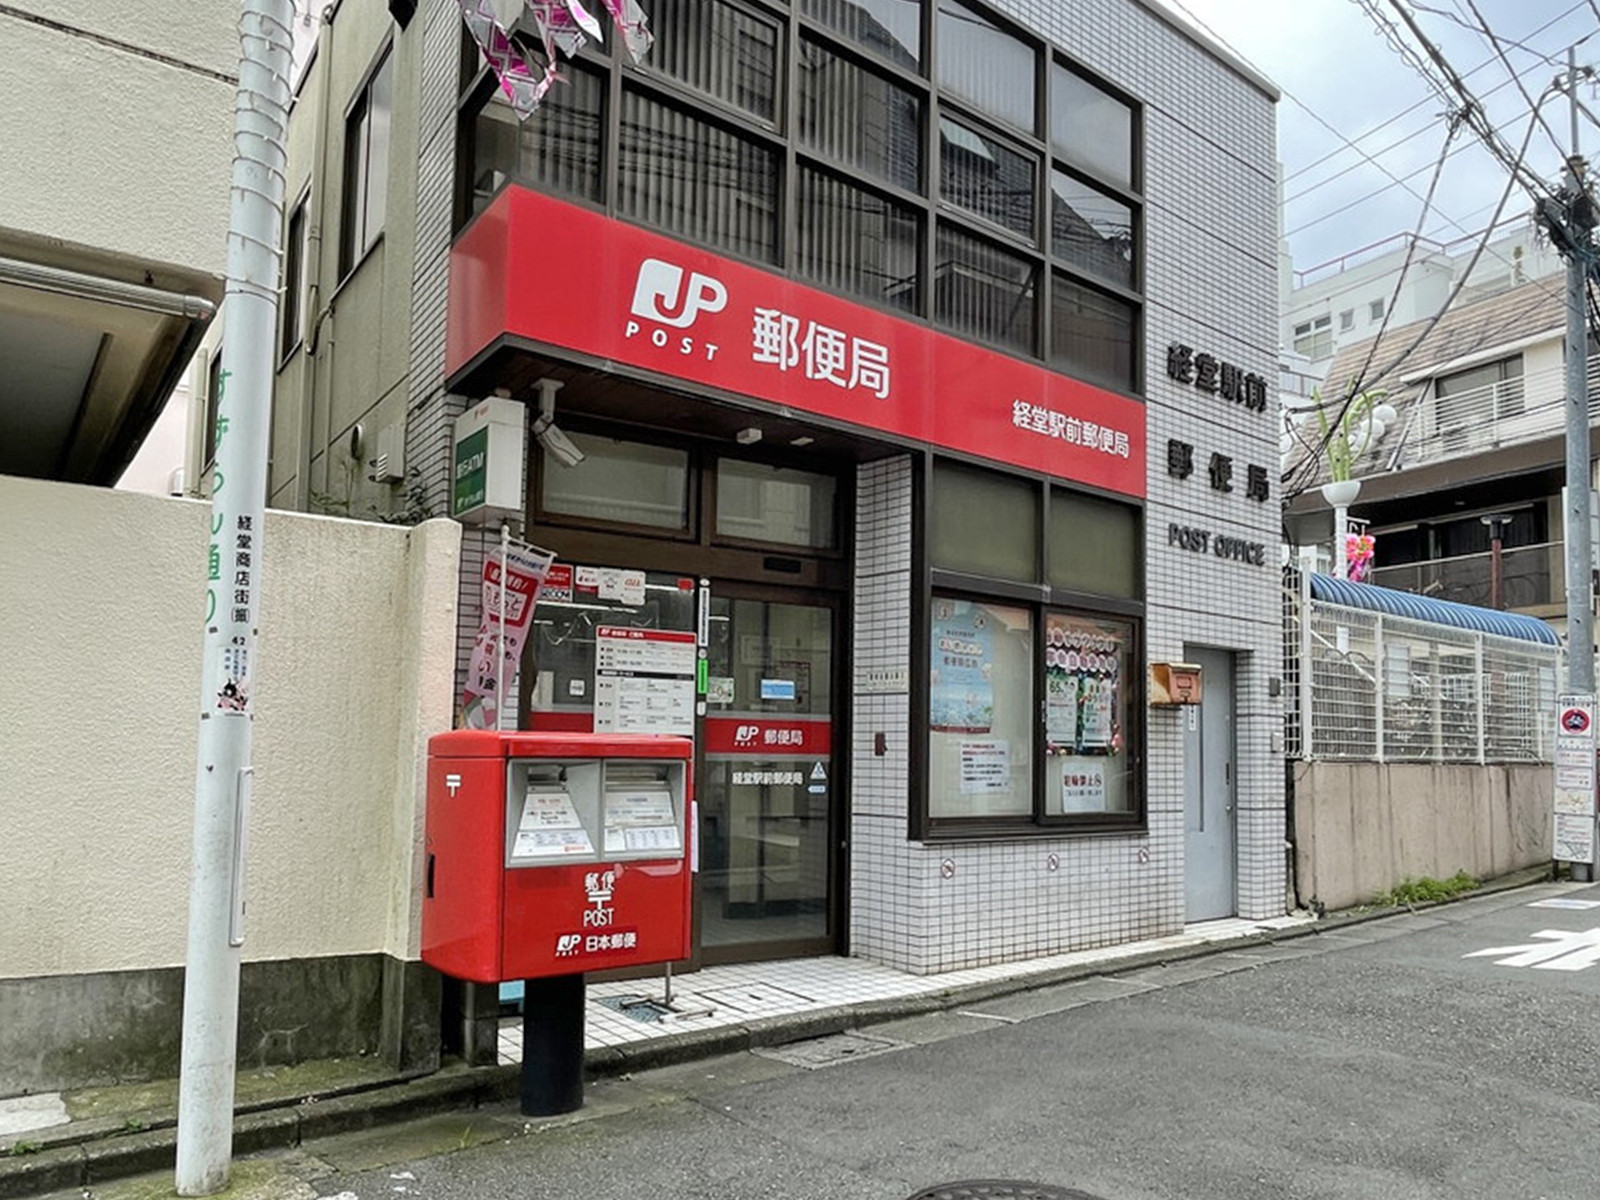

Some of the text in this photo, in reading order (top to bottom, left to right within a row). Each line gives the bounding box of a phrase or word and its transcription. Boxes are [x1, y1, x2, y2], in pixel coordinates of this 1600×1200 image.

[630, 258, 729, 329] JP
[625, 321, 718, 360] POST
[751, 306, 891, 400] 郵便局
[1166, 340, 1268, 414] 経堂駅前
[1012, 399, 1130, 459] 経堂駅前郵便局
[1166, 438, 1270, 503] 郵便局
[1168, 521, 1266, 567] POST OFFICE
[231, 636, 246, 647] 42
[764, 729, 803, 745] 郵便局
[584, 871, 616, 893] 郵便
[583, 907, 615, 928] POST
[586, 933, 635, 952] 日本郵便
